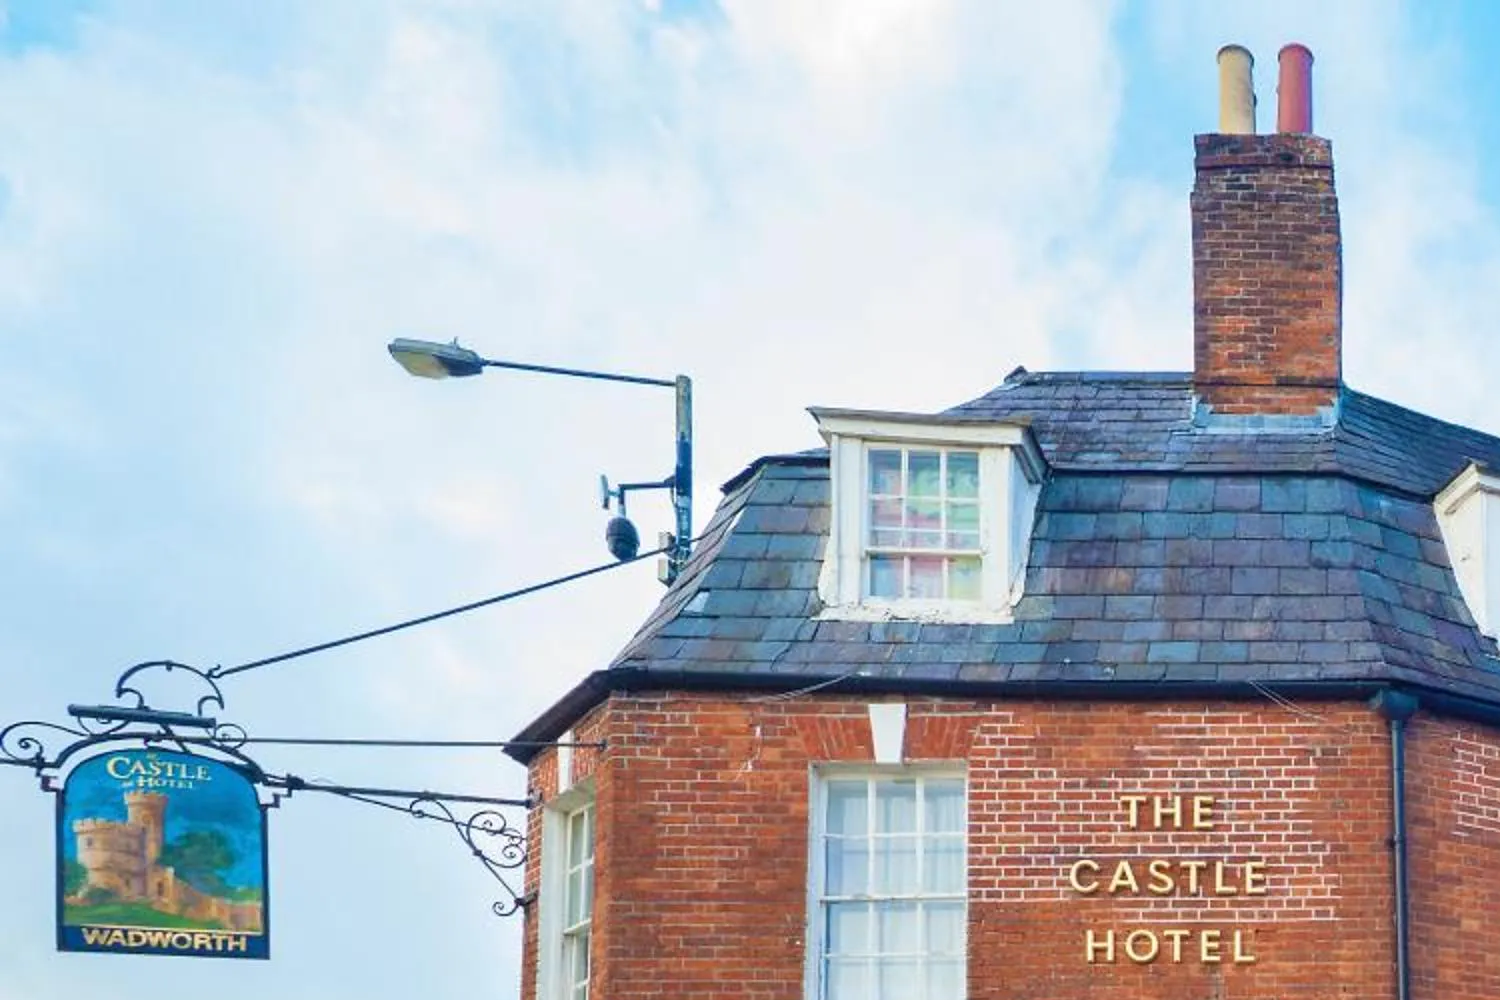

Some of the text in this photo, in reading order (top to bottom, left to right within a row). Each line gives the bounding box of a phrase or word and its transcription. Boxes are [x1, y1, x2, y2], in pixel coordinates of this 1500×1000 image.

[106, 756, 212, 782] CASTLE
[1120, 795, 1216, 828] THE
[1069, 859, 1267, 894] CASTLE
[82, 927, 247, 952] WADWORTH
[1085, 929, 1257, 963] HOTEL
